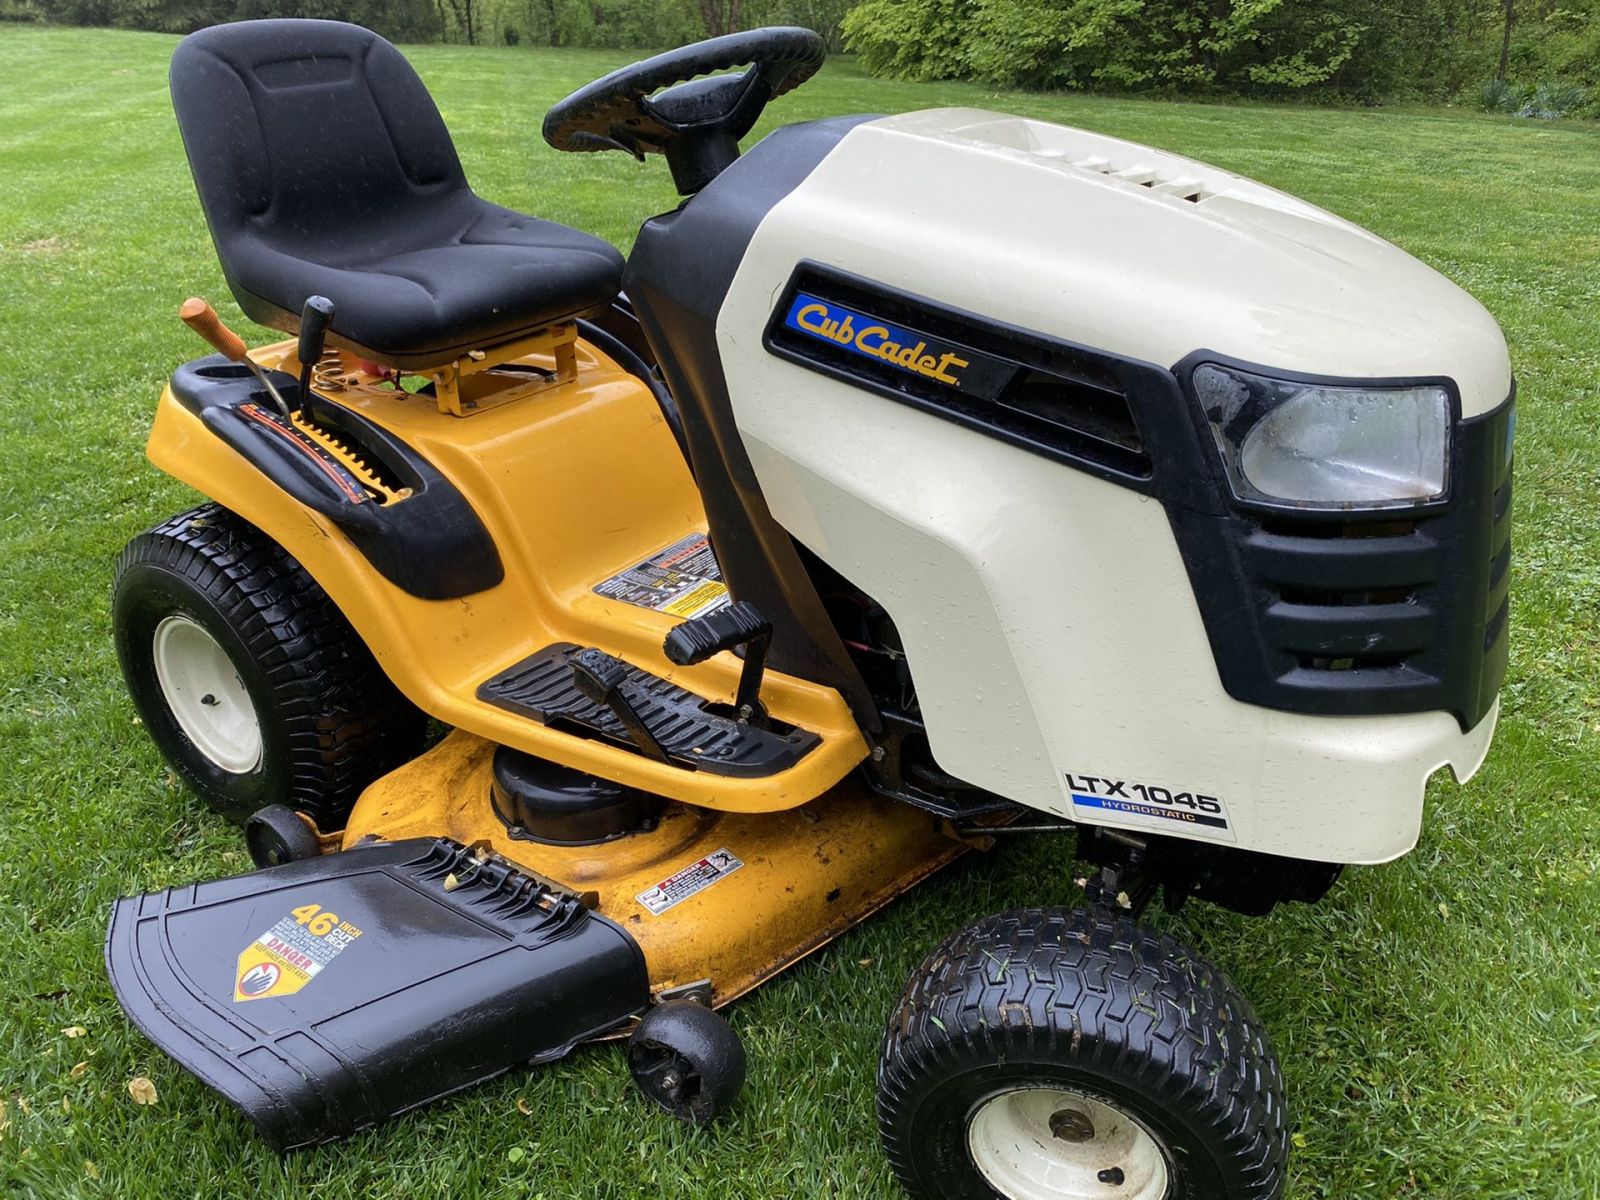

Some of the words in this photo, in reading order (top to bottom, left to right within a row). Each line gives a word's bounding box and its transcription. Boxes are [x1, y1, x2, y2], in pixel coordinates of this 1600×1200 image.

[797, 304, 854, 344] Cub
[855, 326, 969, 385] Cadet
[1101, 800, 1196, 822] HYDROSTATIC
[671, 863, 702, 882] DANGER
[291, 904, 339, 936] 46
[338, 921, 363, 938] INCH
[324, 934, 348, 950] DECK
[332, 928, 355, 943] CUT
[266, 938, 313, 970] DANGER
